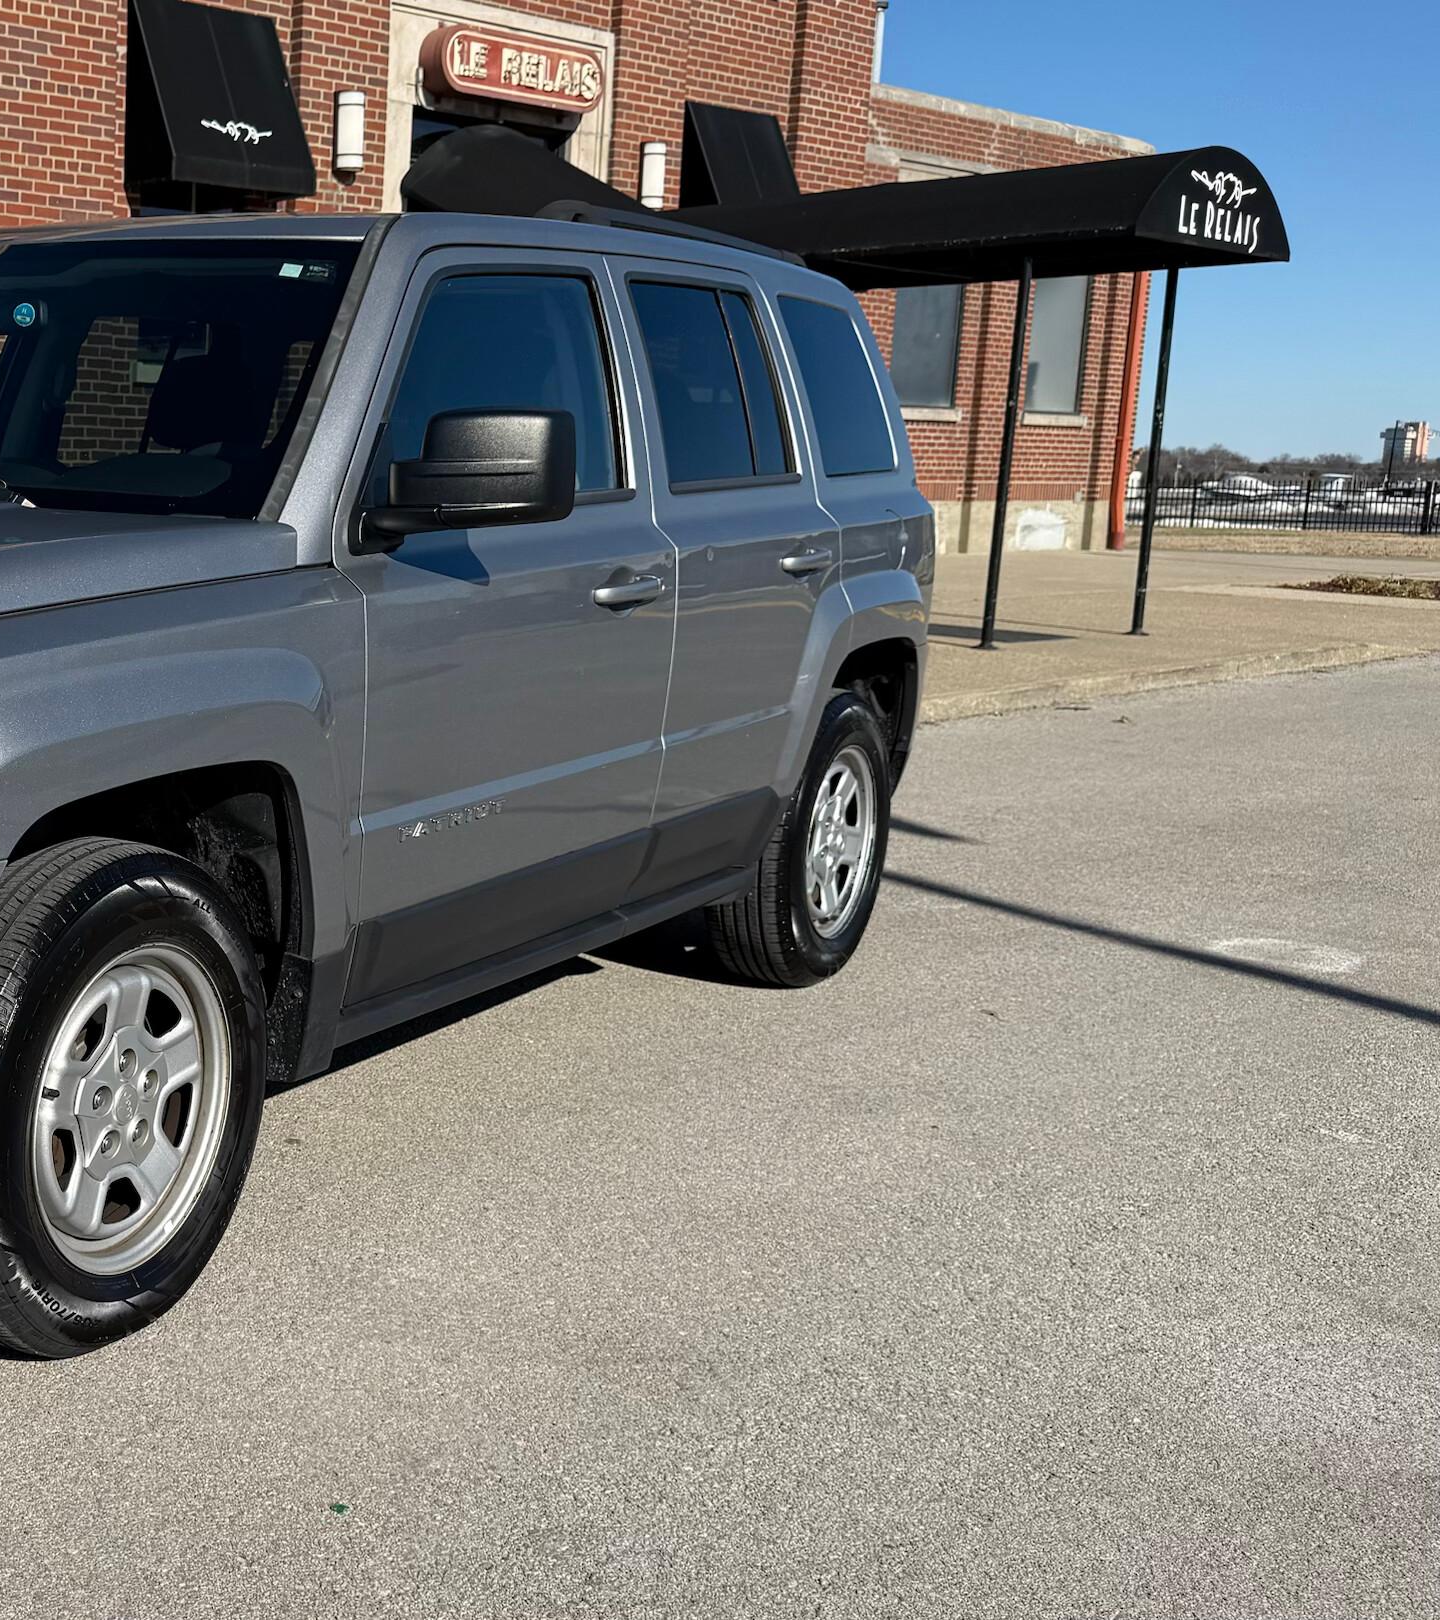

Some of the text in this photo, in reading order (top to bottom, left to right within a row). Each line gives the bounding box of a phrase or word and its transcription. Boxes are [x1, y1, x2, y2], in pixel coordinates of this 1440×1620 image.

[452, 38, 601, 100] LE RELAIS
[1177, 194, 1261, 254] LE RELAIS
[398, 799, 507, 843] PATRIOT
[192, 898, 211, 914] ALL
